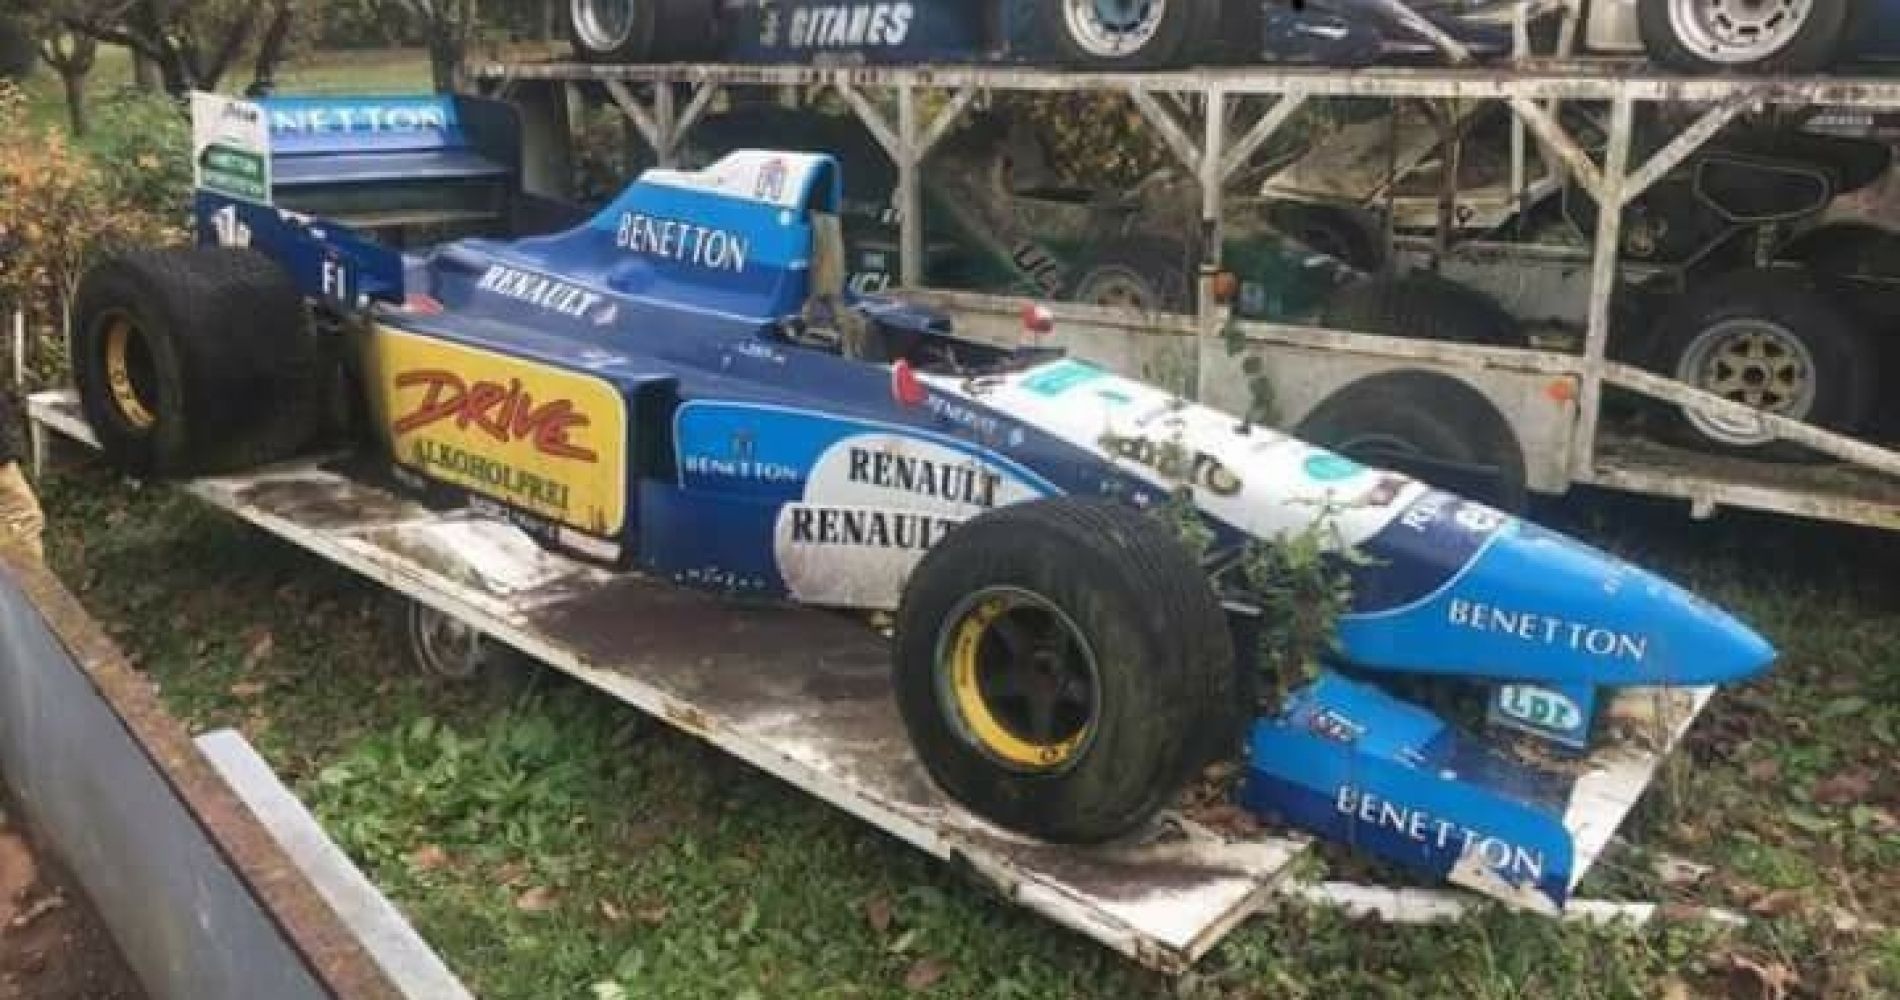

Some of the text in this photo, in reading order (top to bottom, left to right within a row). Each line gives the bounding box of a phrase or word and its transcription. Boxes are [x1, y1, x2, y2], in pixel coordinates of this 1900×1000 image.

[788, 2, 914, 47] GITANES
[615, 210, 749, 273] BENETTON
[475, 263, 602, 317] RENAULT
[410, 437, 570, 510] ALKOHOLFREI
[684, 454, 799, 481] BENETTON
[848, 446, 1003, 507] RENAULT
[1448, 598, 1647, 661] BENETTON
[1336, 784, 1544, 879] BENETTON
